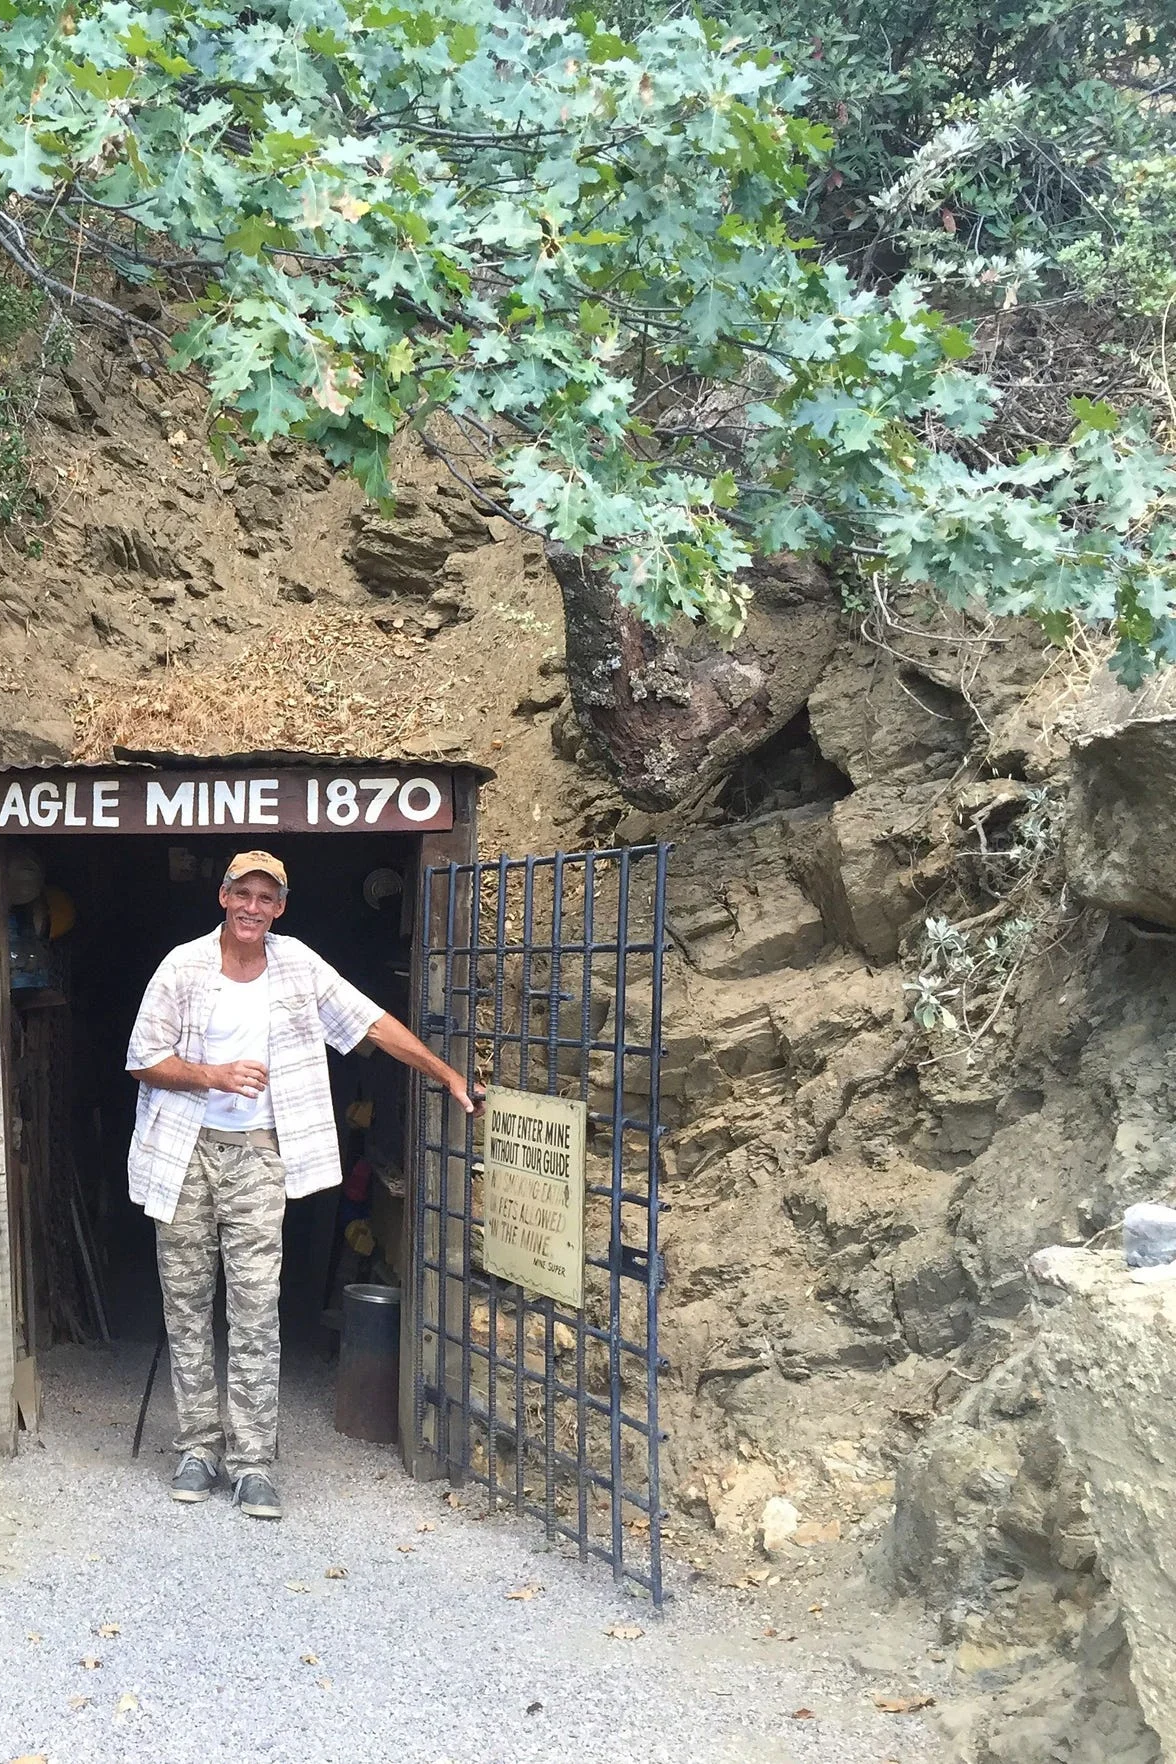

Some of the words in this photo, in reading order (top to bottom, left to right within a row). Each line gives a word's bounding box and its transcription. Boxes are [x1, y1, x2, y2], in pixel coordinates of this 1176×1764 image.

[145, 779, 279, 826] MINE
[307, 777, 441, 827] 1870
[491, 1109, 501, 1133] DO
[501, 1111, 517, 1137] NOT
[517, 1115, 543, 1143] ENTER
[545, 1121, 570, 1149] MINE
[491, 1136, 520, 1165] WITHOUT
[522, 1144, 542, 1175] TOUR
[543, 1149, 570, 1178] GUIDE
[499, 1196, 518, 1220] PETS
[519, 1203, 567, 1234] ALLOWED
[500, 1220, 518, 1245] THE
[547, 1261, 566, 1278] SUPER
